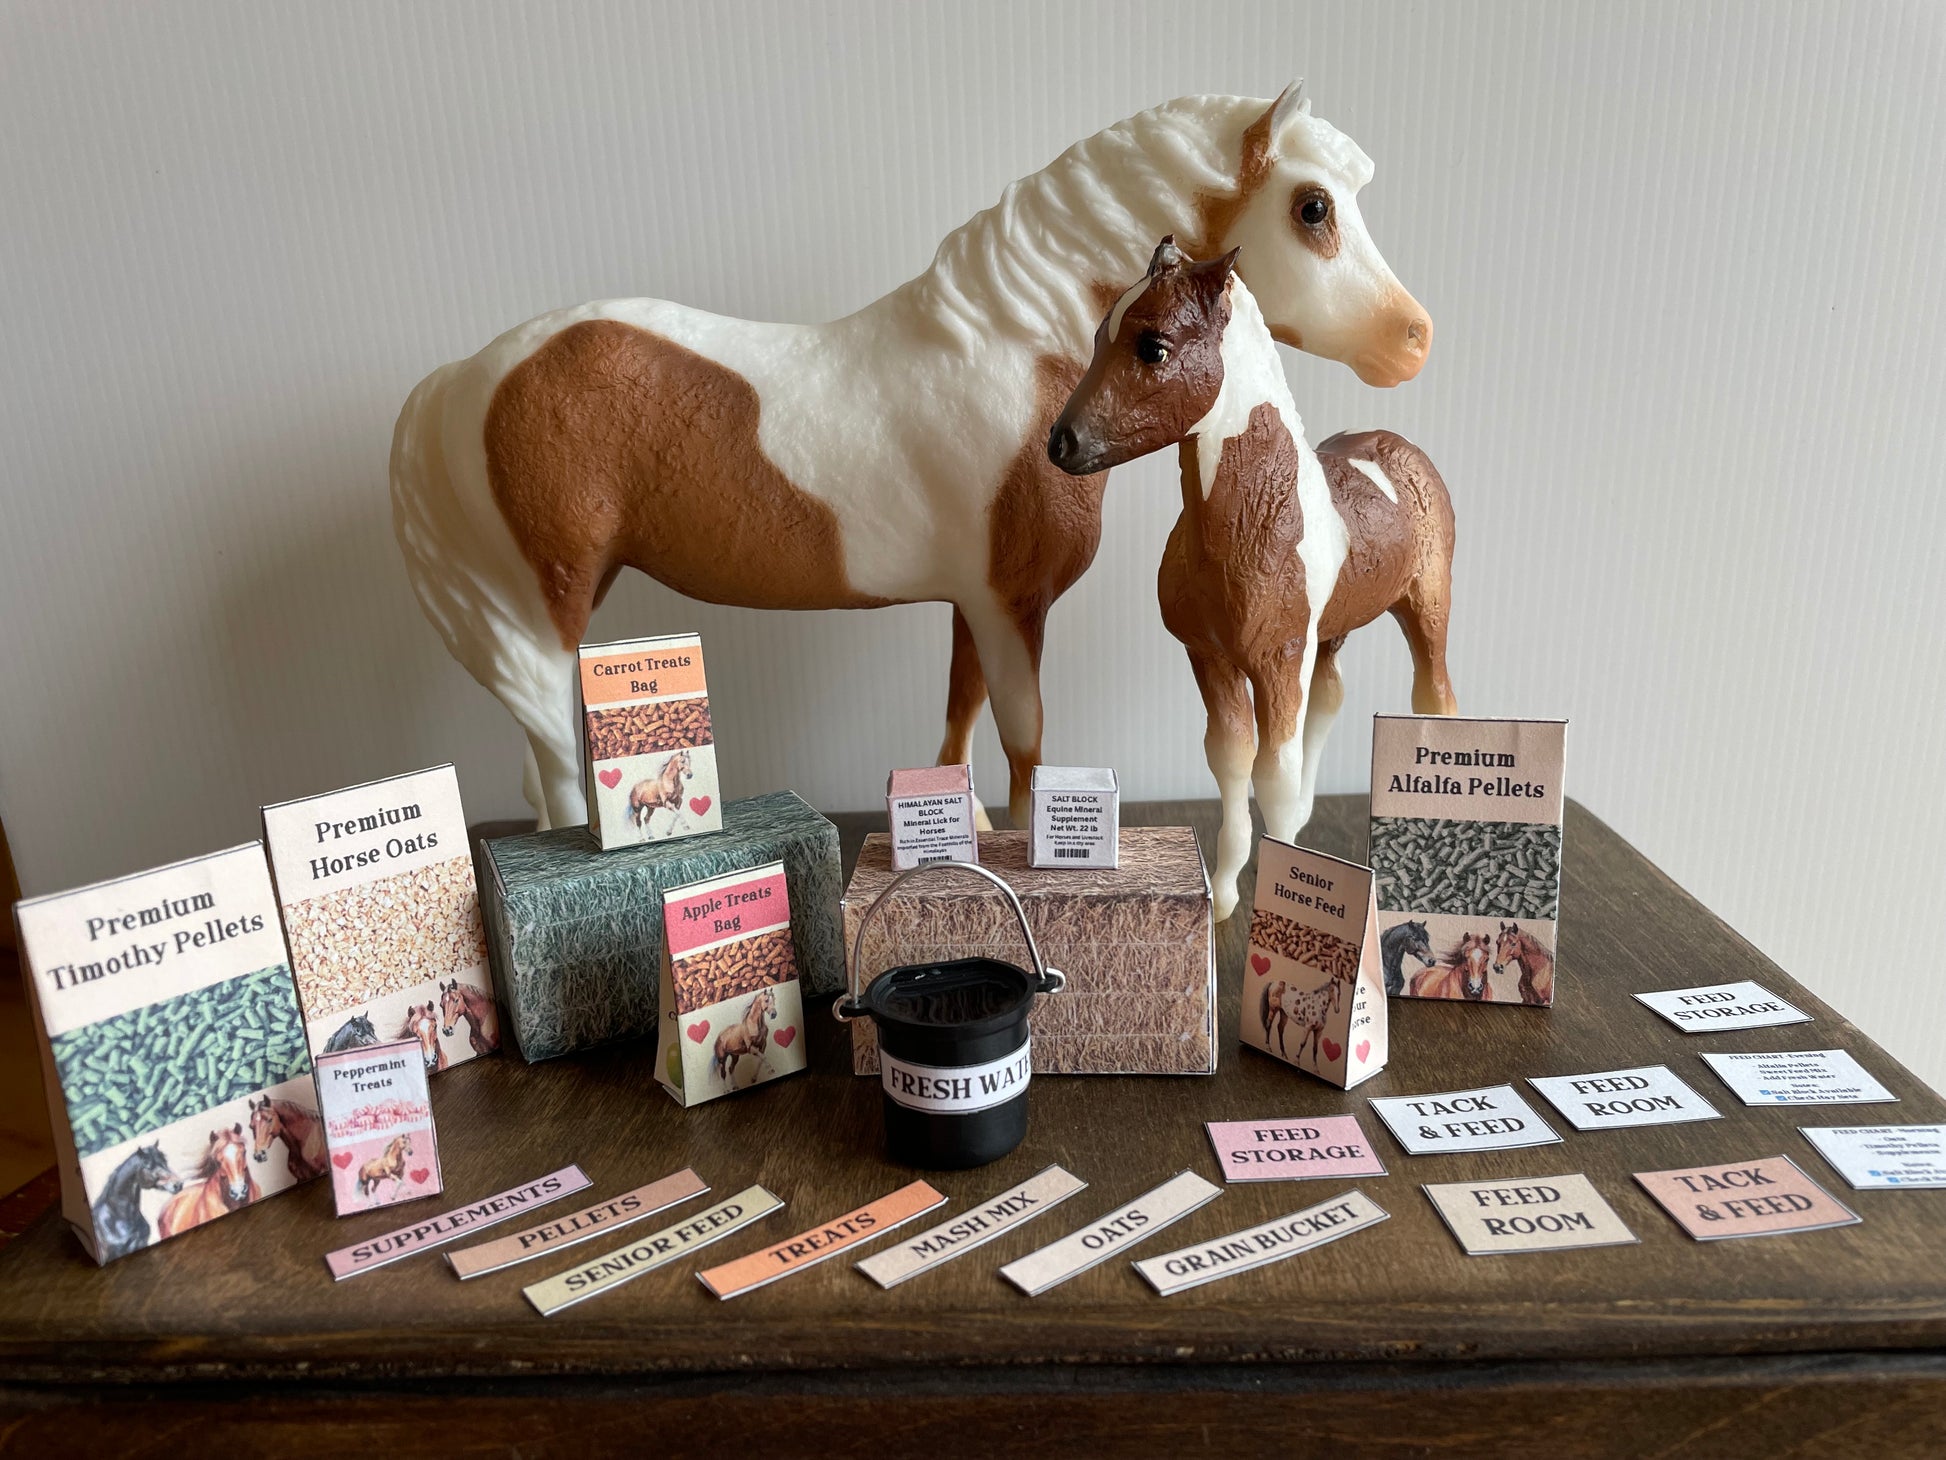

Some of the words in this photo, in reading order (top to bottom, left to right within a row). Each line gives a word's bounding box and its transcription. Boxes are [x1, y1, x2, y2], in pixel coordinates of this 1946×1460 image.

[593, 661, 643, 677] Carrot
[645, 656, 691, 671] Treats
[630, 679, 658, 694] Bag
[1415, 747, 1515, 768] Premium
[1388, 774, 1462, 796] Alfalfa
[1467, 777, 1545, 799] Pellets
[898, 798, 943, 809] HIMALAYAN
[918, 808, 944, 817] BLOCK
[1046, 806, 1073, 814] Equine
[315, 803, 422, 843] Premium
[904, 819, 932, 827] Mineral
[1052, 815, 1098, 824] Supplement
[310, 847, 381, 880] Horse
[387, 832, 439, 859] Oats
[1289, 866, 1334, 892] Senior
[682, 900, 722, 921] Apple
[724, 886, 772, 908] Treats
[1274, 883, 1312, 909] Horse
[1314, 898, 1346, 919] Feed
[86, 892, 215, 941] Premium
[714, 916, 741, 933] Bag
[46, 937, 169, 992] Timothy
[174, 912, 265, 955] Pellets
[1678, 990, 1736, 1006] FEED
[1674, 1001, 1785, 1022] STORAGE
[333, 1059, 407, 1080] Peppermint
[352, 1078, 393, 1092] Treats
[890, 1066, 972, 1100] FRESH
[1570, 1076, 1650, 1095] FEED
[1405, 1096, 1498, 1118] TACK
[1583, 1095, 1685, 1116] ROOM
[1253, 1127, 1321, 1143] FEED
[1418, 1123, 1444, 1140] &
[1446, 1116, 1526, 1138] FEED
[1232, 1144, 1366, 1165] STORAGE
[1674, 1168, 1778, 1194] TACK
[1470, 1186, 1562, 1208] FEED
[1695, 1202, 1722, 1222] &
[1723, 1194, 1814, 1218] FEED
[352, 1178, 562, 1263] SUPPLEMENTS
[519, 1196, 642, 1250] PELLETS
[910, 1217, 991, 1259] MASH
[990, 1190, 1039, 1222] MIX
[1082, 1209, 1149, 1251] OATS
[1484, 1212, 1595, 1237] ROOM
[565, 1237, 674, 1292] SENIOR
[677, 1204, 745, 1243] FEED
[768, 1213, 876, 1265] TREATS
[1165, 1238, 1257, 1278] GRAIN
[1250, 1202, 1360, 1251] BUCKET
